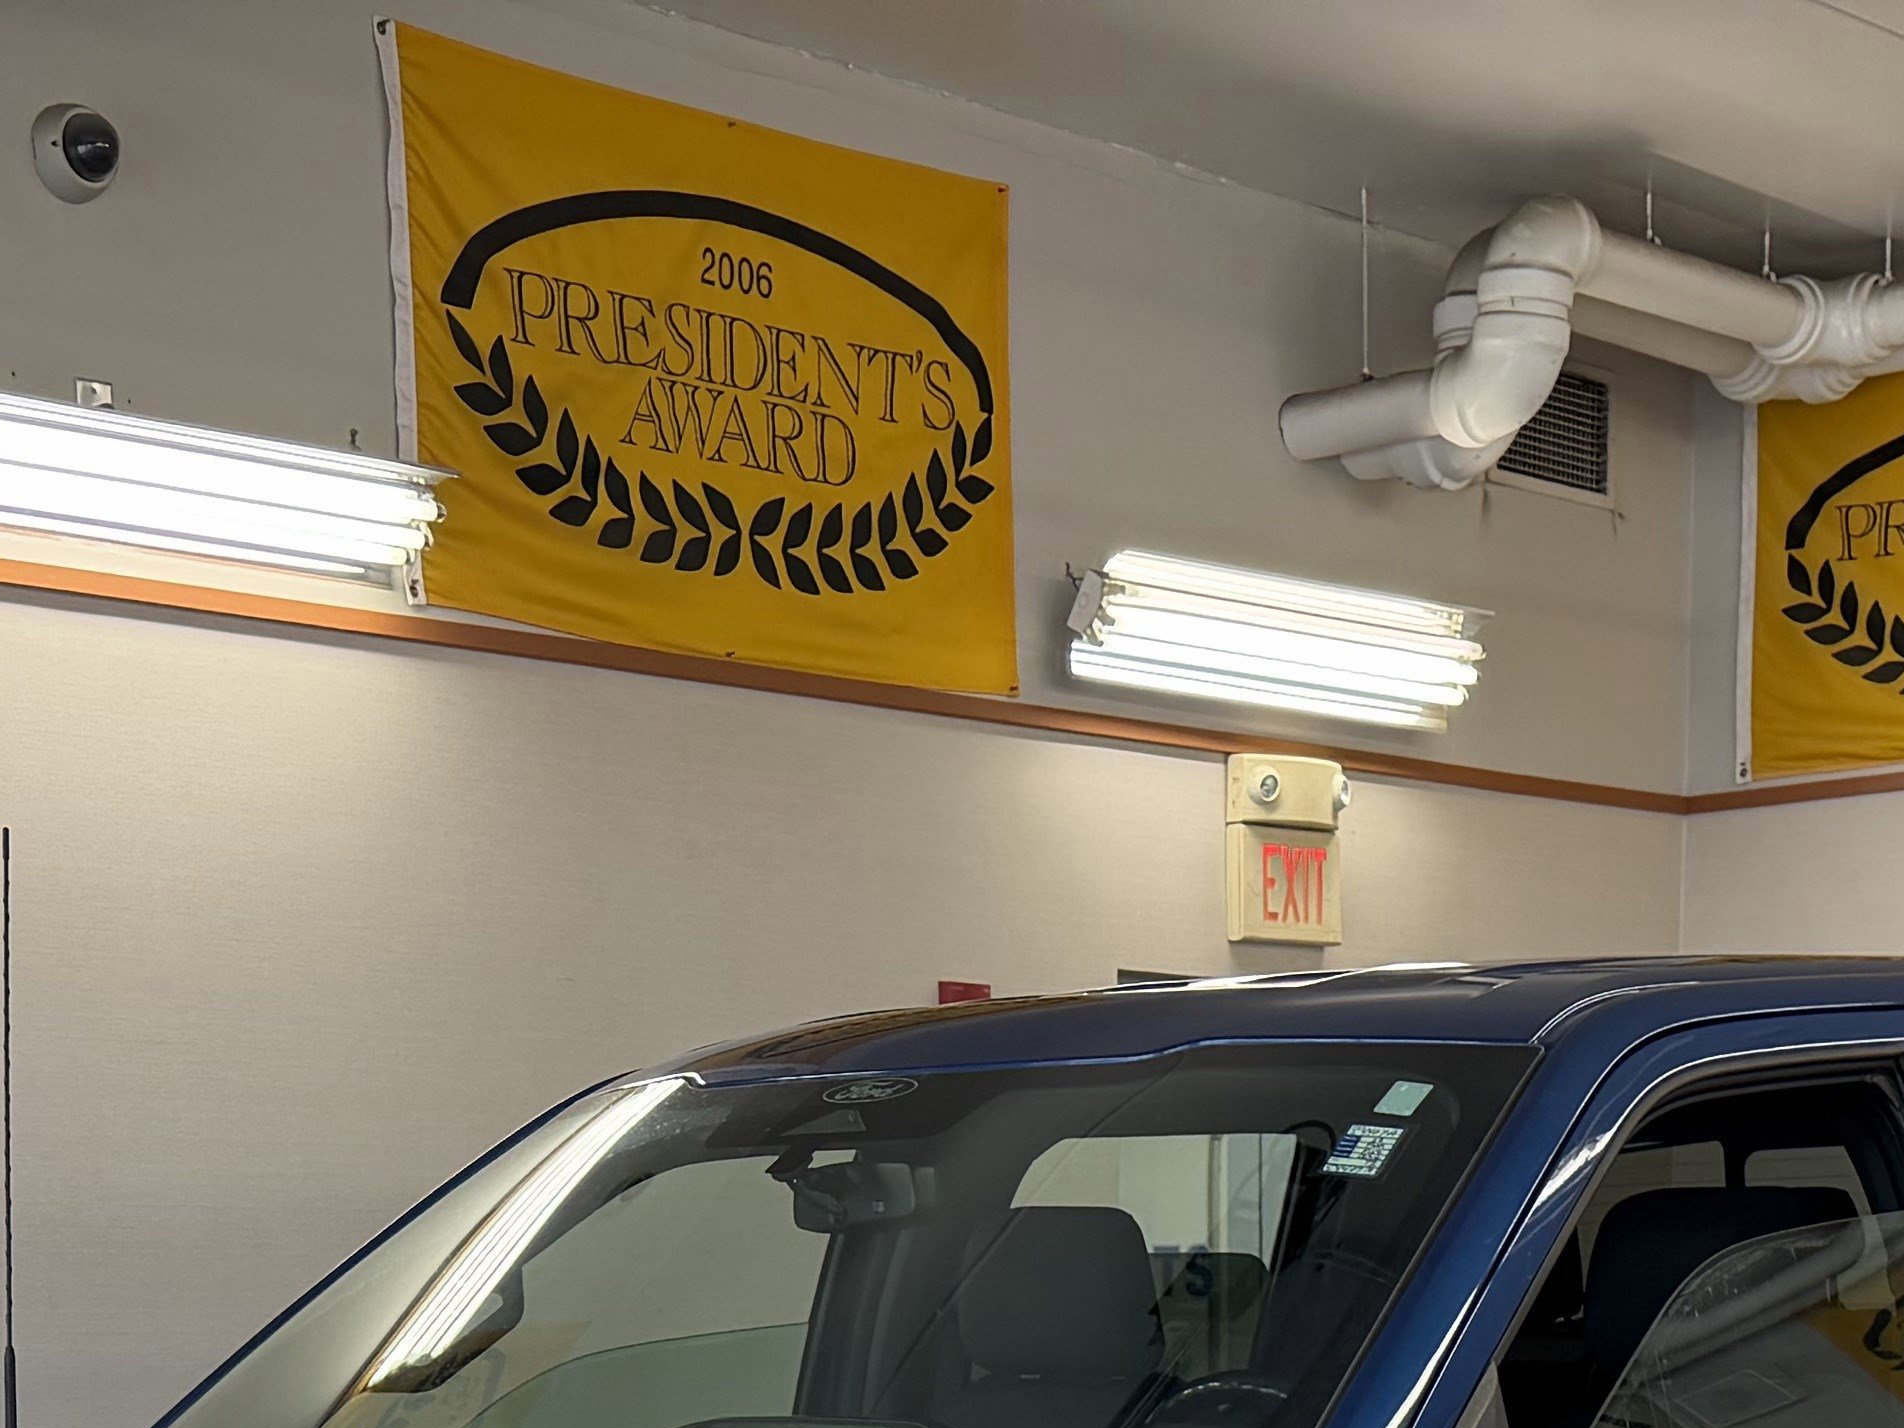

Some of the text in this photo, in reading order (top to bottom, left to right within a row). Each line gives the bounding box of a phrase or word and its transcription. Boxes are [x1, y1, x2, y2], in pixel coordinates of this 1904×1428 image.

[701, 247, 773, 299] 2006
[502, 267, 957, 431] PRESIDENT'S
[619, 376, 858, 486] AWARD
[1262, 843, 1328, 926] EXIT
